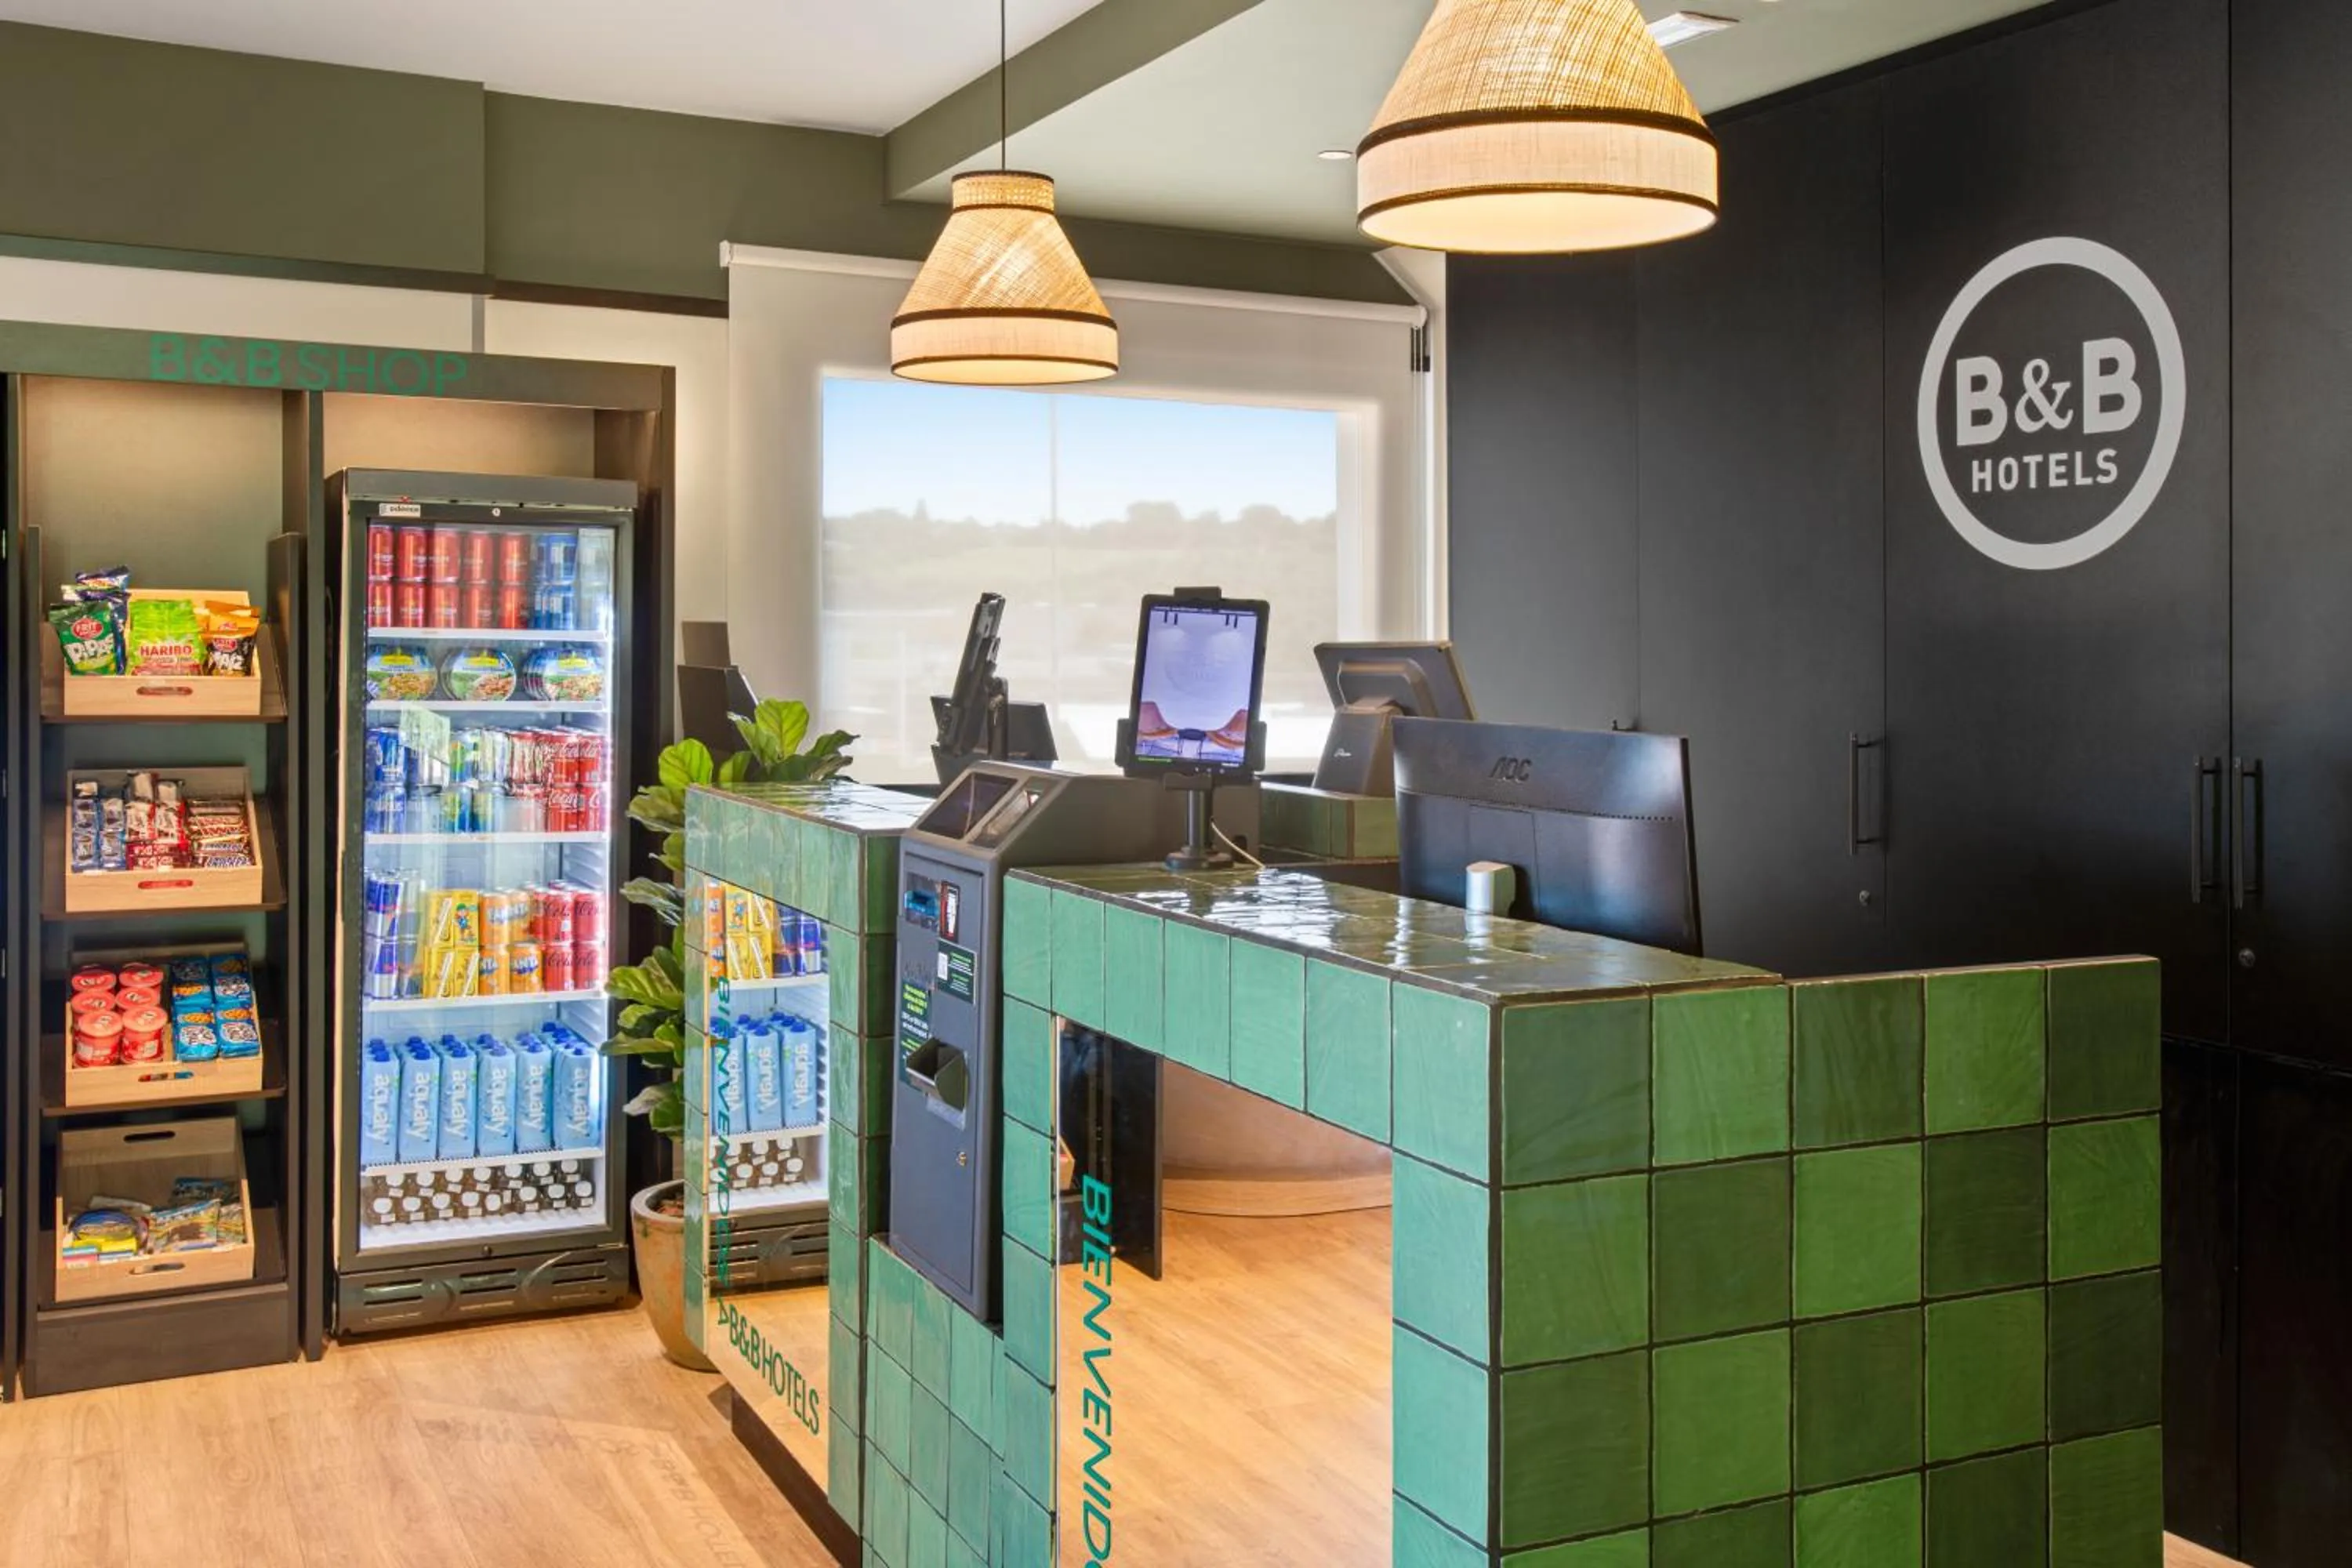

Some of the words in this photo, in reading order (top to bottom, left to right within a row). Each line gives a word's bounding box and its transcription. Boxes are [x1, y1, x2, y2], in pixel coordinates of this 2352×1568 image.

[149, 333, 282, 387] B&B
[296, 343, 468, 397] SHOP
[1956, 336, 2143, 447] B&B
[1971, 448, 2118, 493] HOTELS
[140, 645, 193, 656] HARIBO
[1488, 757, 1533, 781] AOC
[405, 1072, 431, 1139] aqualy
[445, 1069, 468, 1136] aqualy
[484, 1068, 508, 1134] aqualy
[522, 1065, 545, 1129] aqualy
[566, 1068, 590, 1133] aqualy
[729, 1304, 760, 1370] B&B
[762, 1338, 819, 1436] HOTELS
